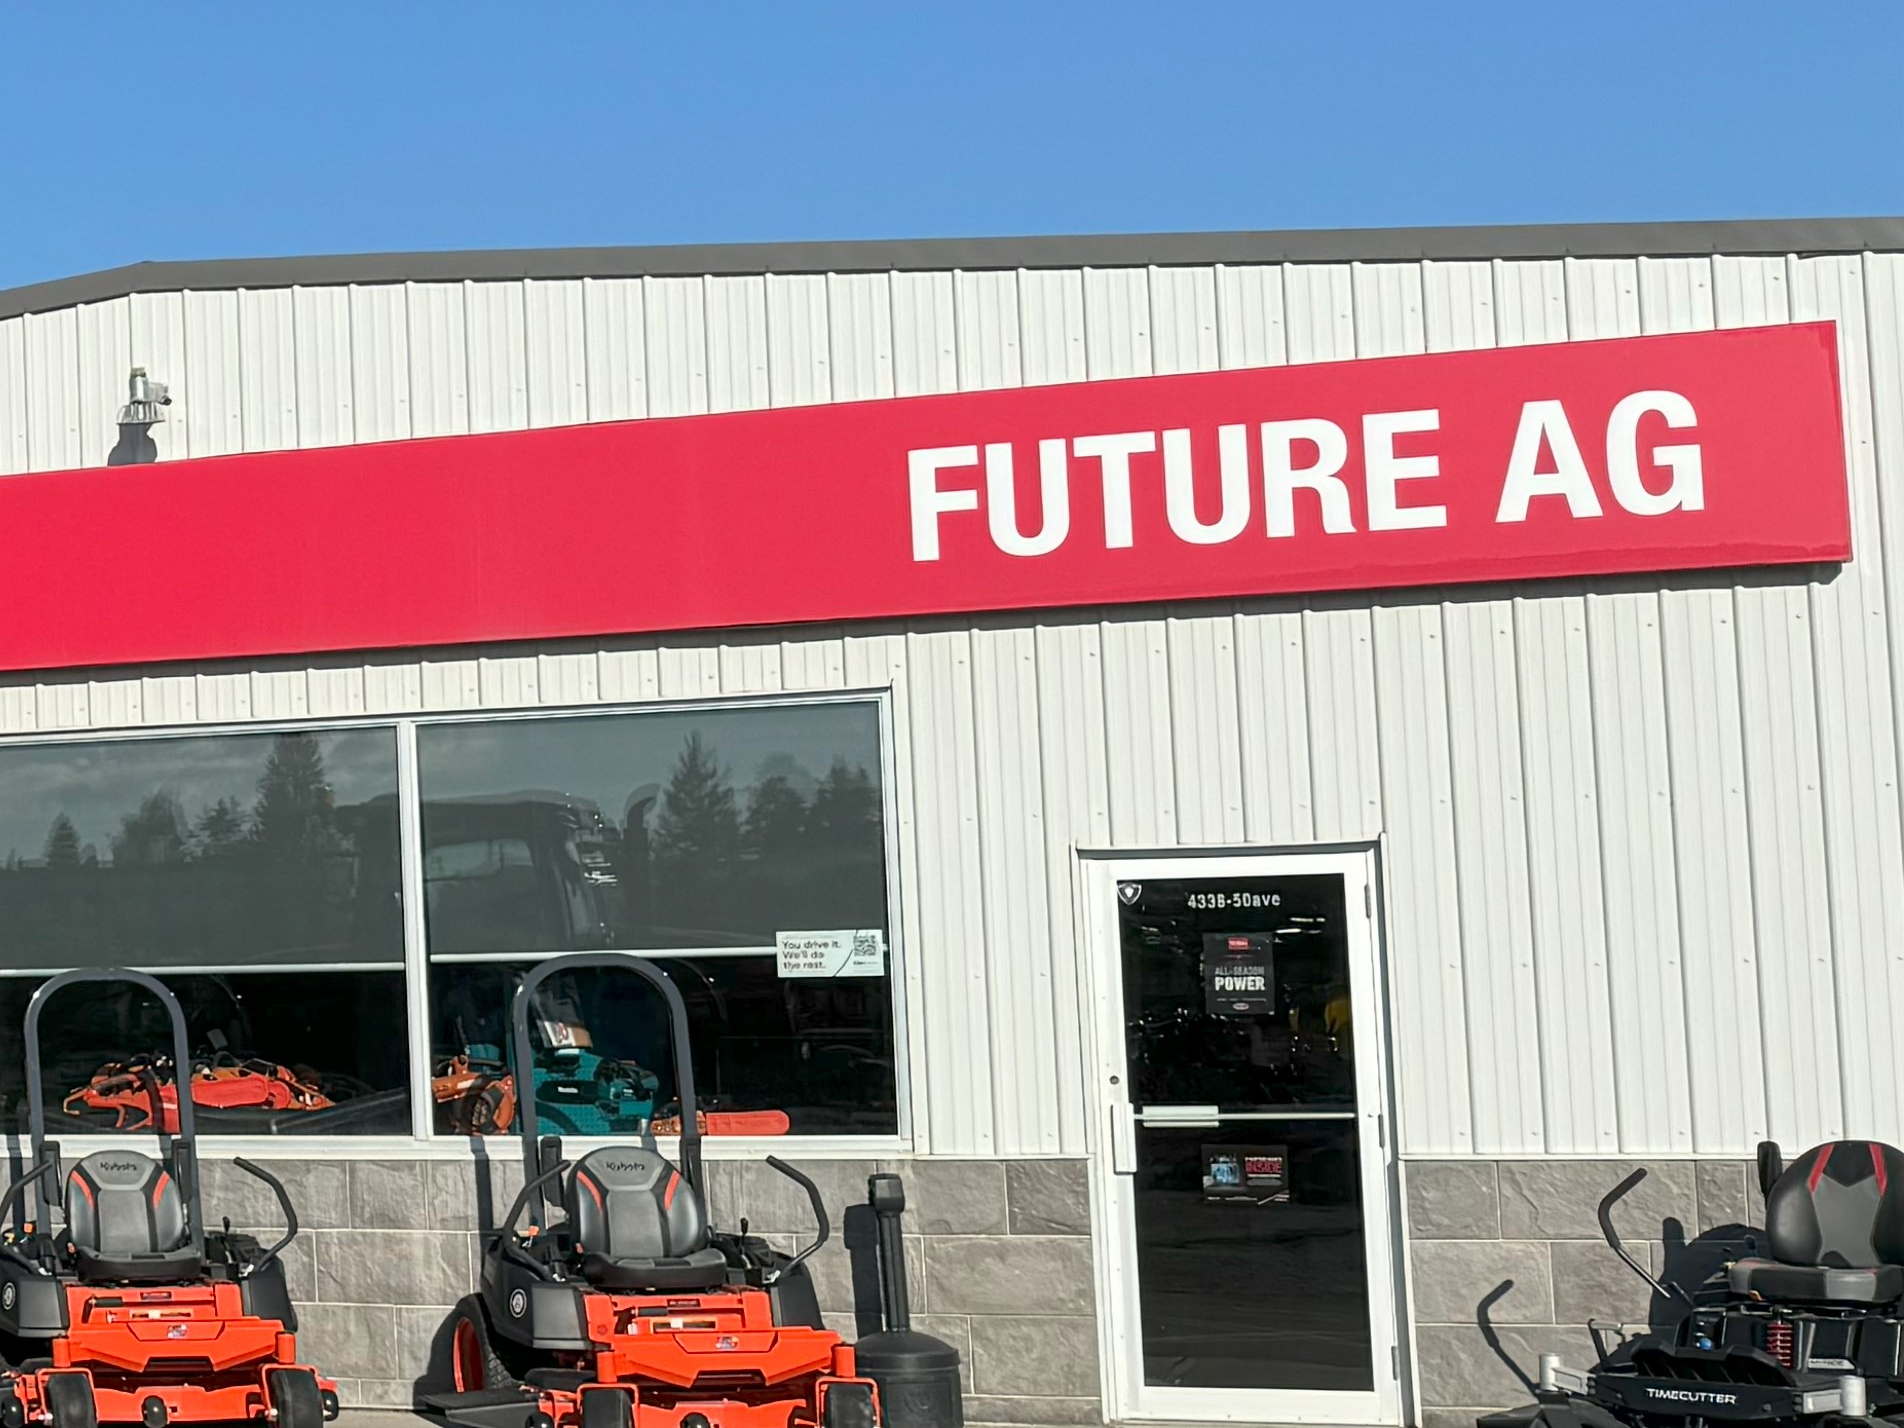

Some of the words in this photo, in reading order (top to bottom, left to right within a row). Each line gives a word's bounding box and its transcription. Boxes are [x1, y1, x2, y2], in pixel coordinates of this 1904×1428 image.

[907, 408, 1448, 563] FUTURE
[1494, 389, 1706, 523] AG
[782, 941, 801, 950] You
[804, 940, 829, 949] drive
[782, 951, 808, 960] We'll
[811, 951, 825, 959] do
[783, 961, 801, 970] the
[1214, 976, 1266, 991] POWER
[1645, 1387, 1737, 1405] TIMECUTTER
